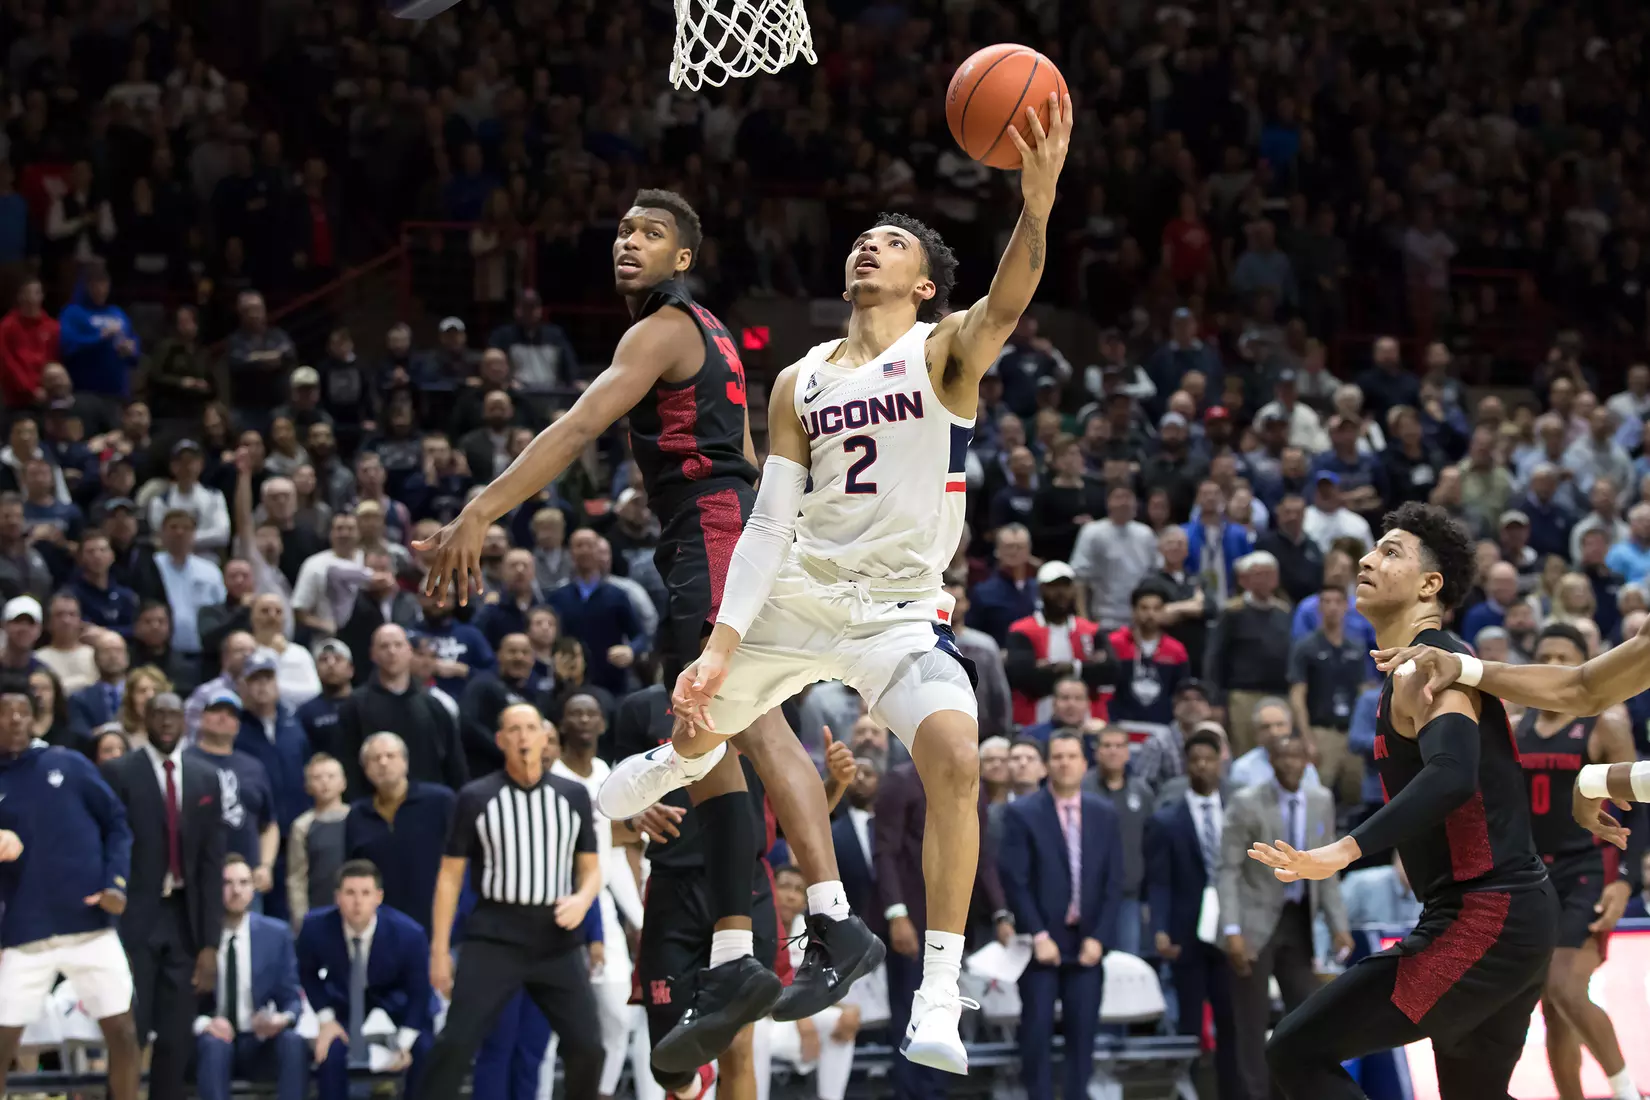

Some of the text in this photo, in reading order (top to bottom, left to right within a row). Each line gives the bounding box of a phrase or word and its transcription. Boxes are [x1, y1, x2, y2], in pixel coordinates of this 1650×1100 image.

[800, 390, 924, 441] UCONN
[843, 435, 877, 494] 2
[1531, 774, 1551, 815] 0
